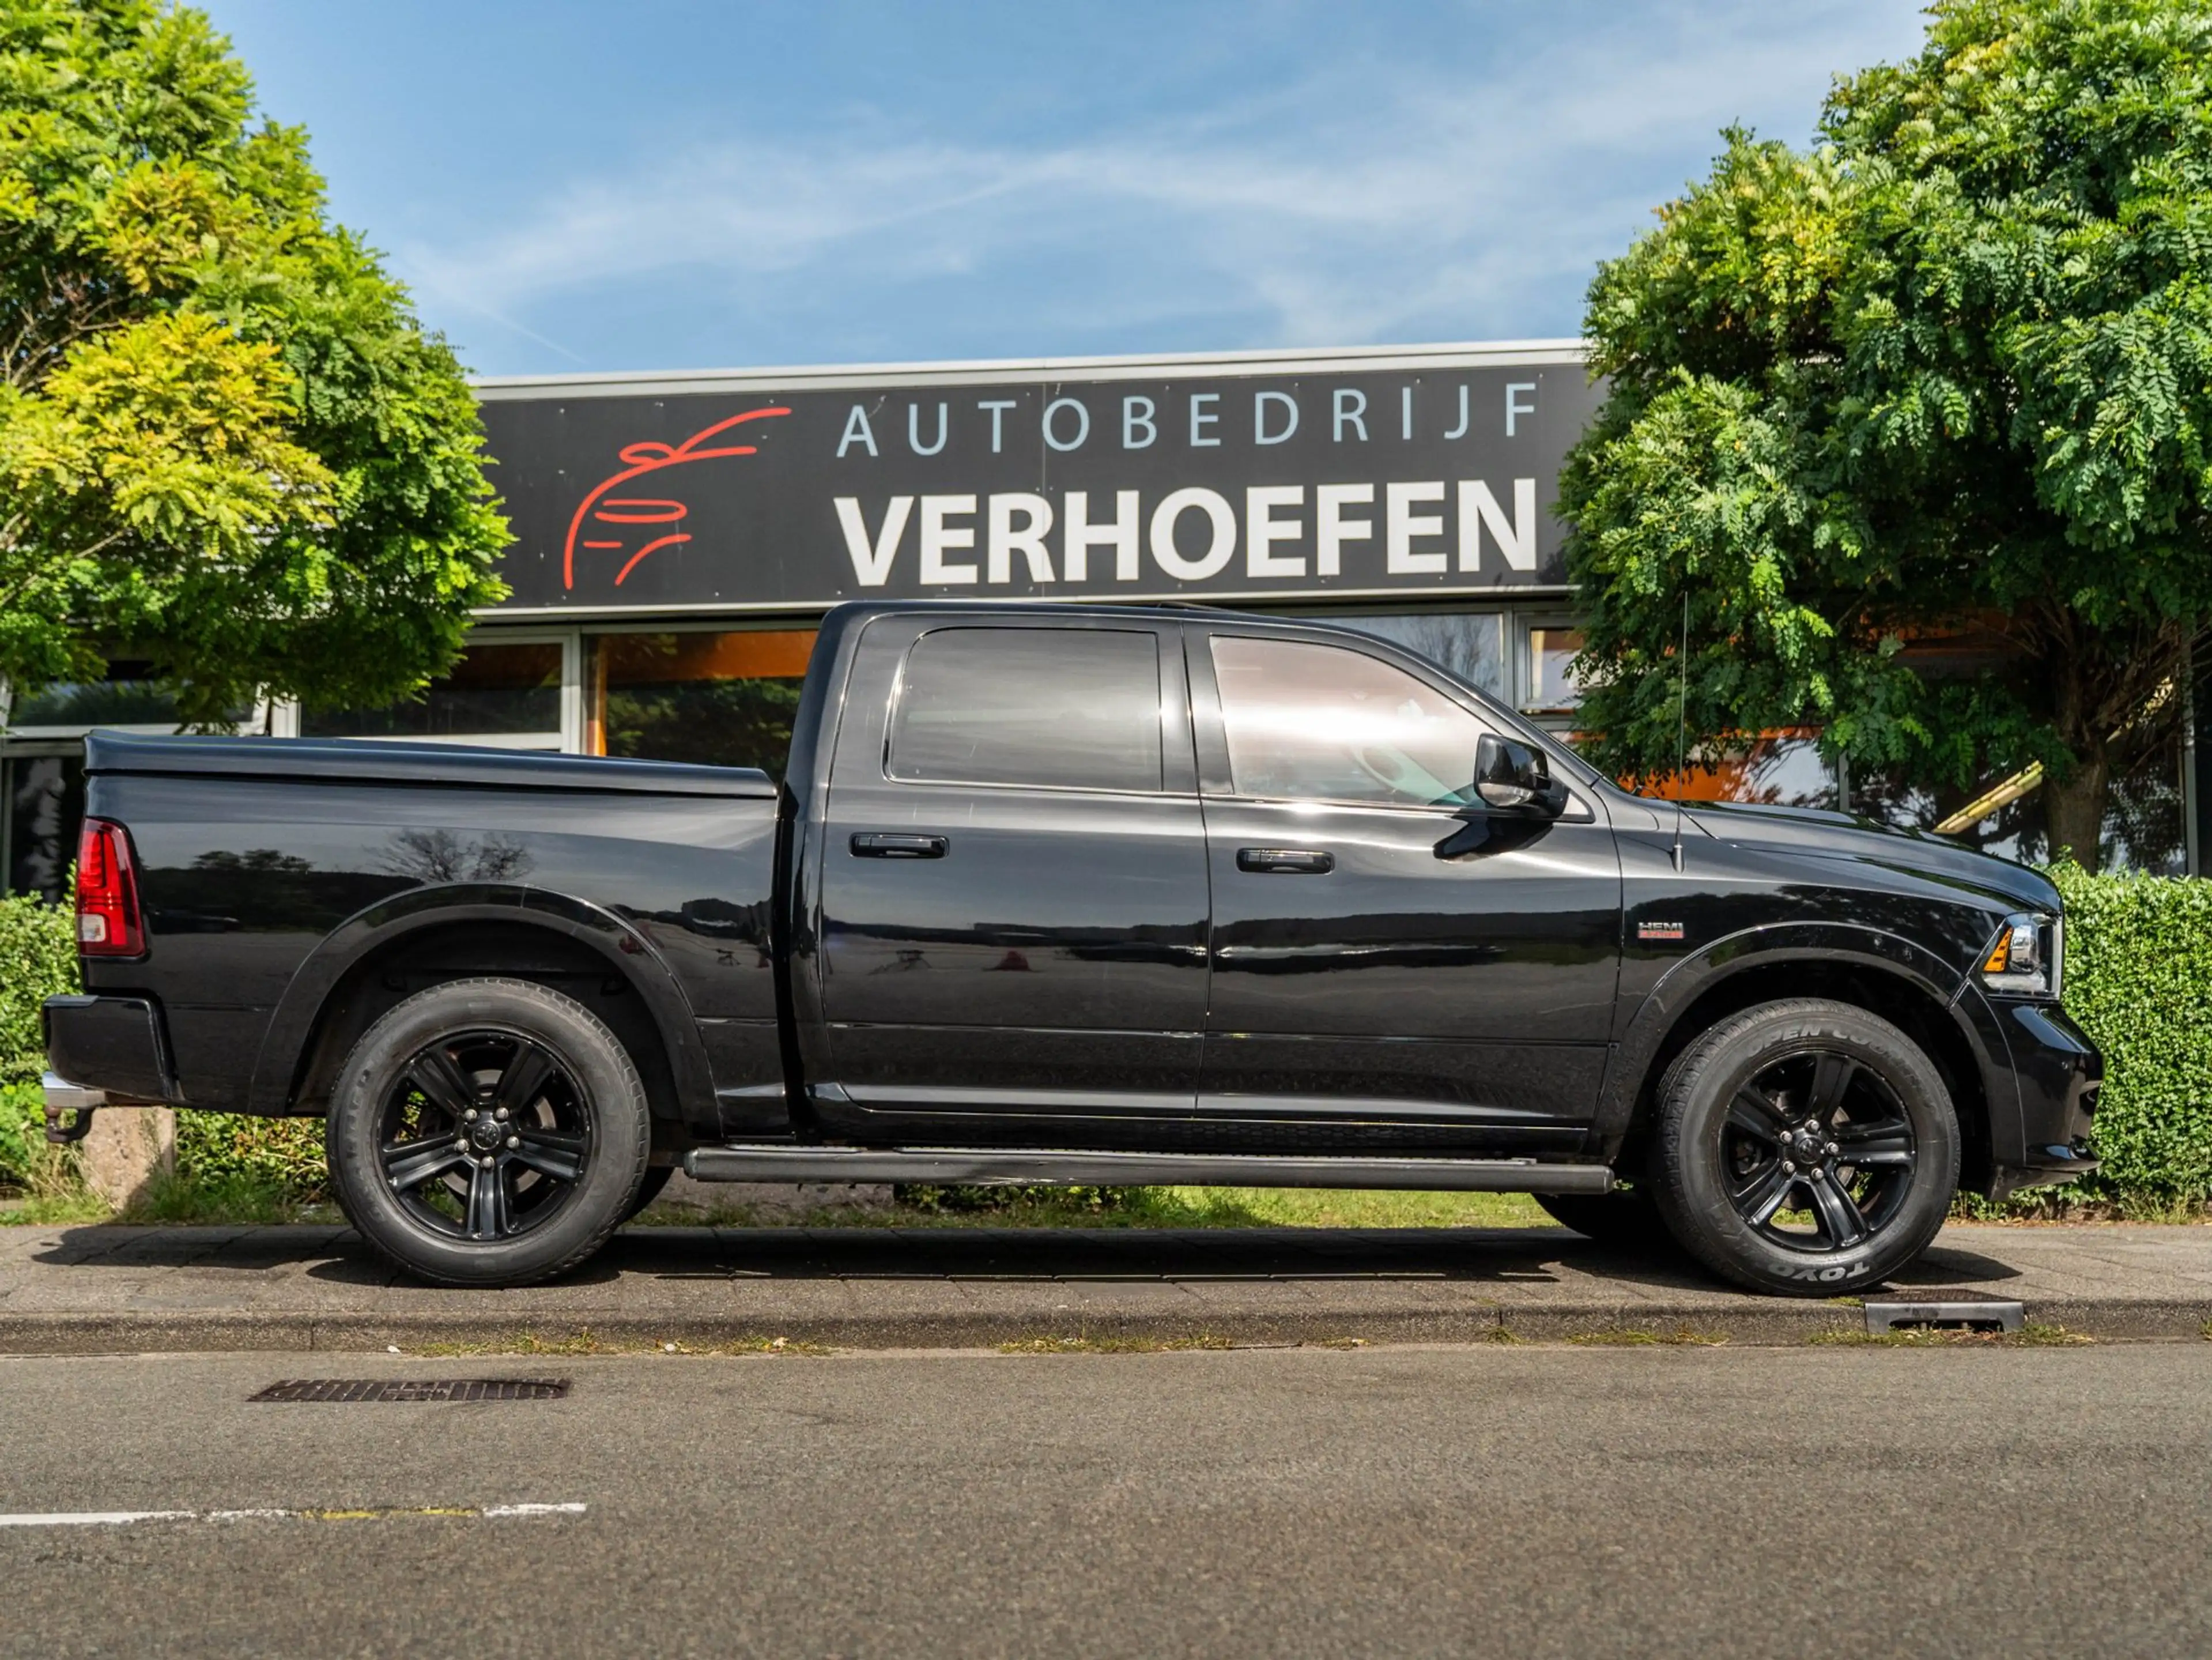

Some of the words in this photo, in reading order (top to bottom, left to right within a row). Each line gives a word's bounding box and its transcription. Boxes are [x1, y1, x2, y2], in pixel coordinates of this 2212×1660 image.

[836, 382, 1536, 458] AUTOBEDRIJF
[833, 478, 1537, 586] VERHOEFEN
[1638, 922, 1683, 930] HEMI
[1749, 1024, 1822, 1058] OPEN
[1768, 1261, 1870, 1281] TOYO
